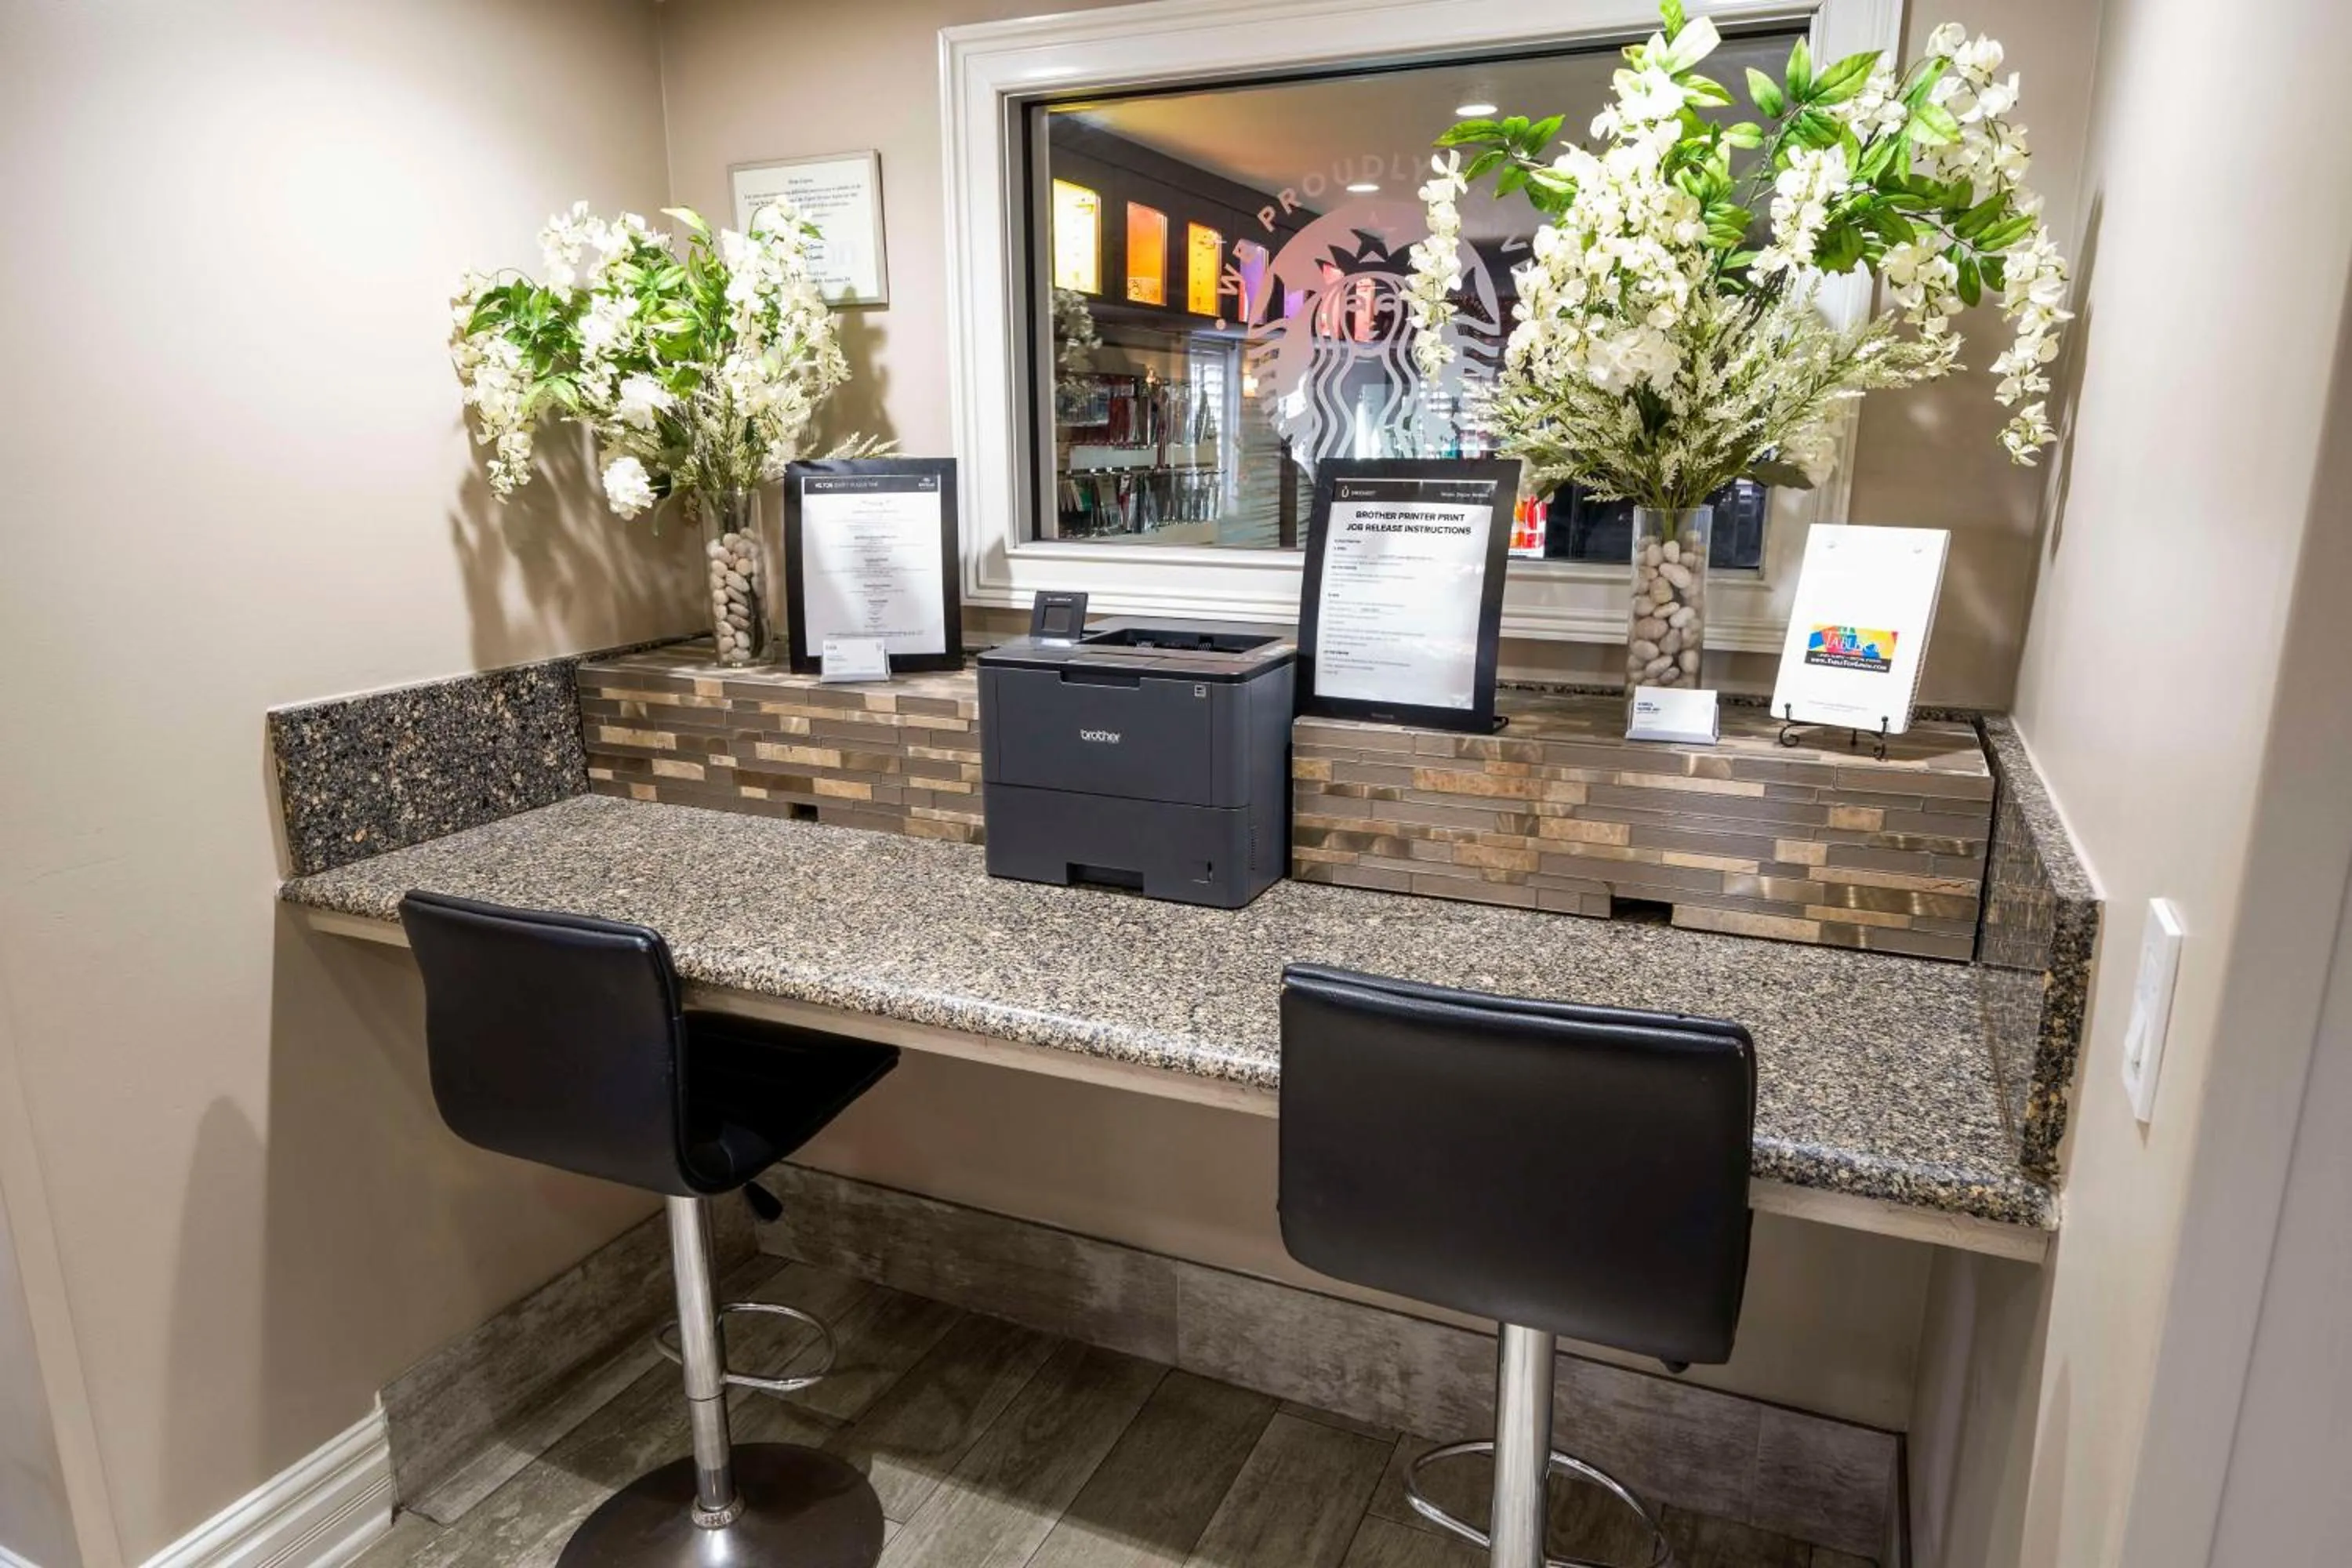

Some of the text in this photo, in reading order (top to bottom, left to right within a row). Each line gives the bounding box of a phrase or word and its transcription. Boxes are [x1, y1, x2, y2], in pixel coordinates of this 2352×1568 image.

[1257, 154, 1432, 233] PROUDLY
[1356, 510, 1465, 522] BROTHER PRINTER PRINT
[1365, 524, 1403, 532] RELEASE
[1404, 524, 1472, 535] INSTRUCTIONS
[1080, 729, 1120, 744] brother
